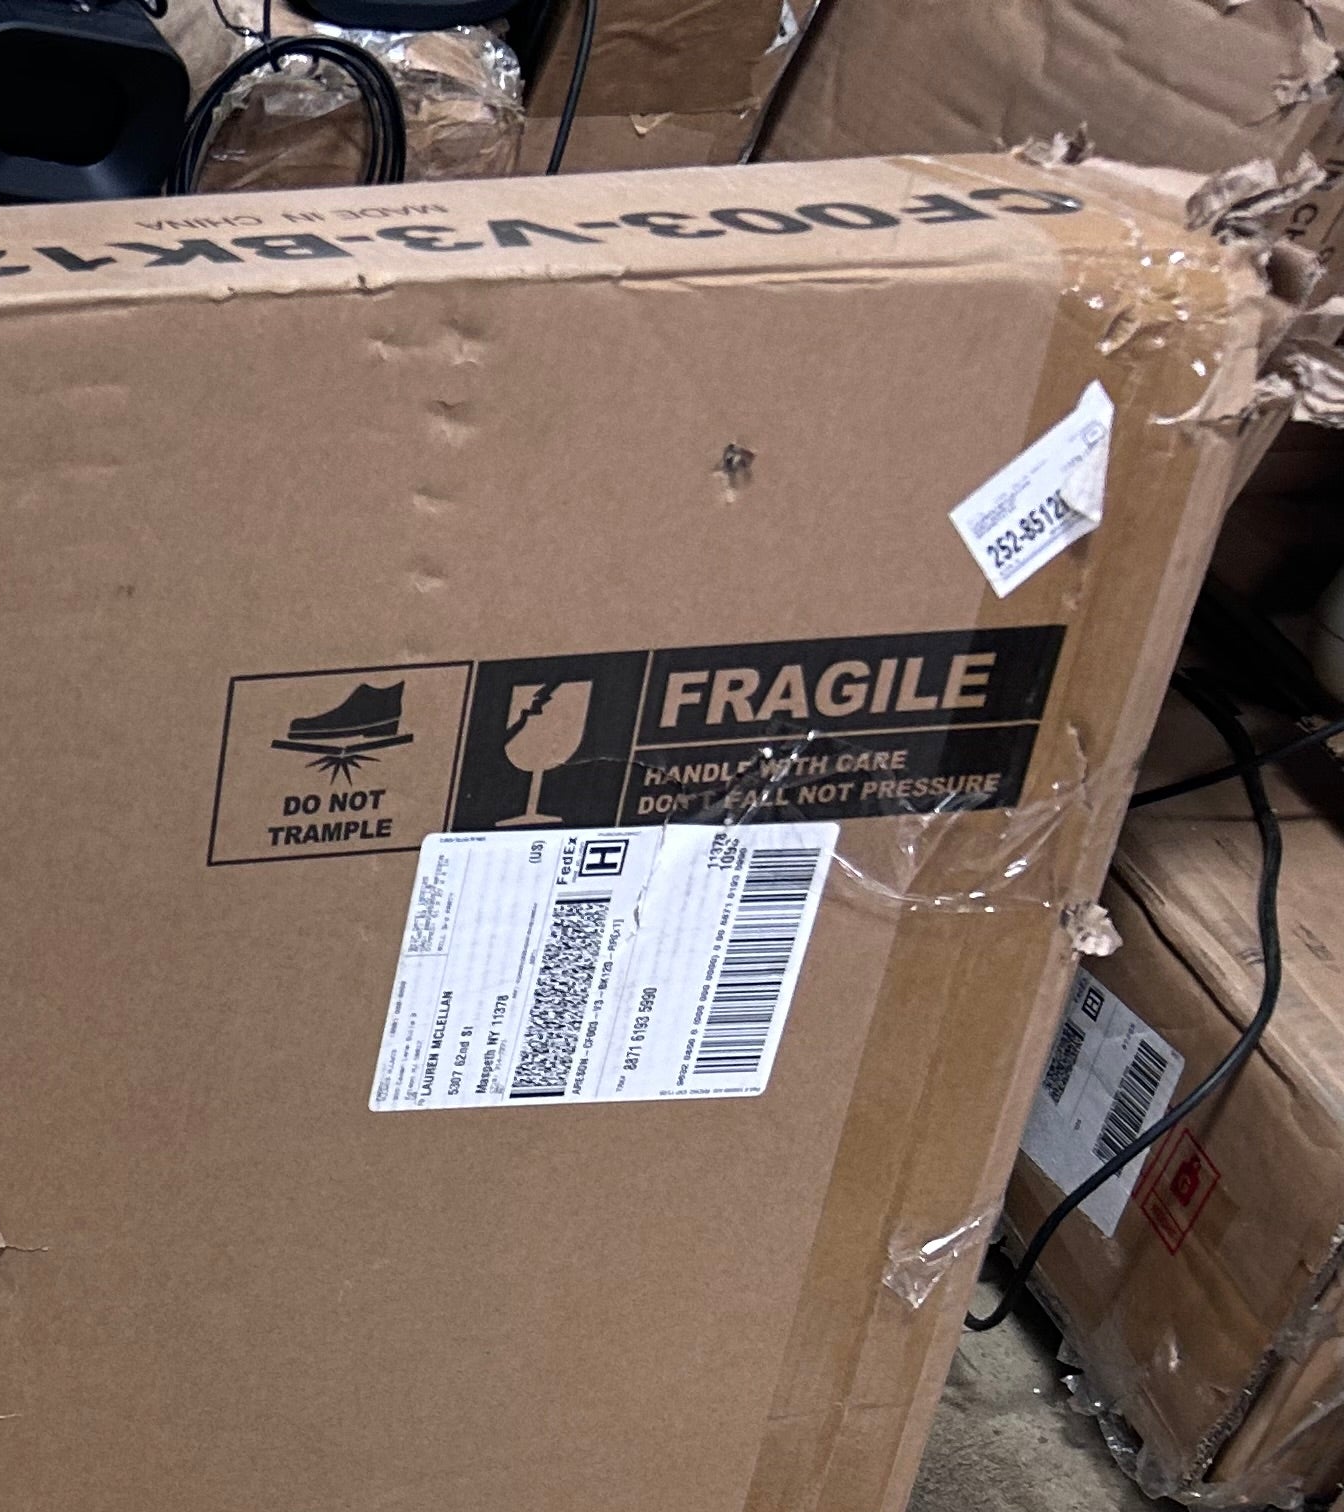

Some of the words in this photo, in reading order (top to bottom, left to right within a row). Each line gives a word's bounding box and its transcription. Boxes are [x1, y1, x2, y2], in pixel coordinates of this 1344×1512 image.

[137, 214, 265, 232] CHINA
[285, 210, 327, 224] IN
[335, 203, 449, 222] MADE
[658, 651, 997, 729] FRAGILE
[834, 749, 910, 774] CARE
[797, 782, 855, 806] NOT
[860, 772, 1002, 801] PRESSURE
[281, 793, 321, 818] DO
[326, 788, 386, 814] NOT
[267, 817, 394, 847] TRAMPLE
[528, 840, 548, 864] (US)
[555, 836, 578, 886] FedEx
[585, 846, 622, 871] H
[707, 832, 728, 869] 11378
[491, 994, 510, 1027] 11378
[638, 987, 658, 1013] 5990
[486, 1030, 501, 1046] NY
[630, 1016, 650, 1042] 6193
[420, 1053, 439, 1097] LAUREN
[431, 990, 454, 1049] MCLELLAN
[454, 1041, 470, 1067] 62nd
[622, 1045, 643, 1071] 8871
[447, 1070, 463, 1096] 5307
[475, 1050, 497, 1094] Maspeth
